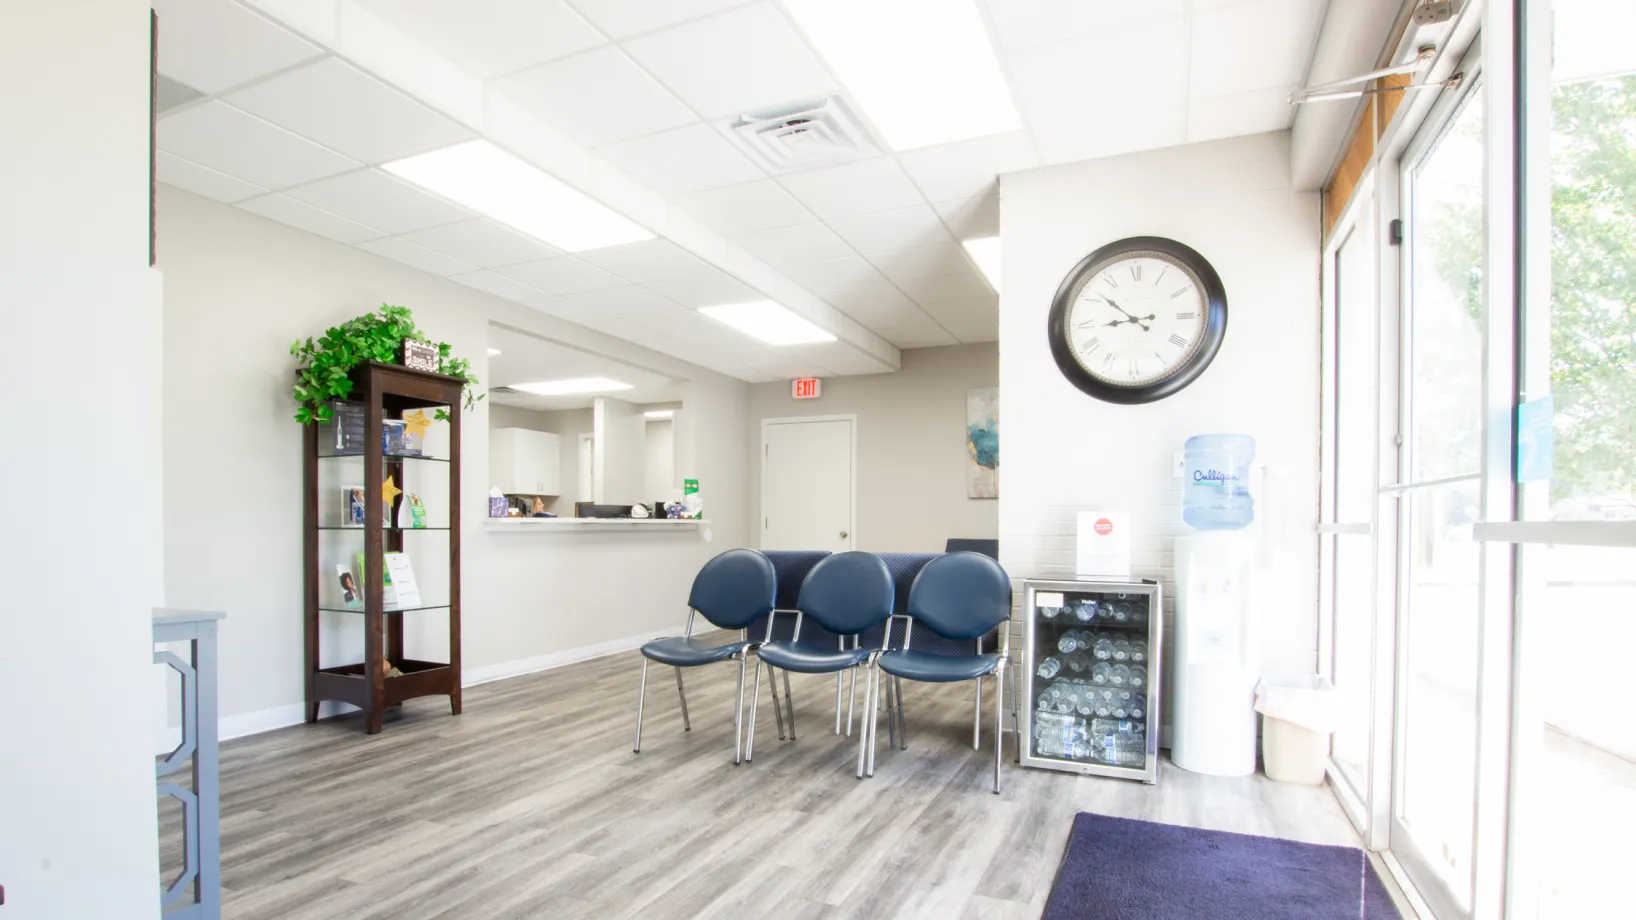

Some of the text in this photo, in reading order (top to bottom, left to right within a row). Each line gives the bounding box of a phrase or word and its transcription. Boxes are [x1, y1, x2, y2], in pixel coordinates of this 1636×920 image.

[411, 356, 433, 368] SMILE
[797, 379, 816, 396] EXIT
[1193, 469, 1239, 486] Culligan
